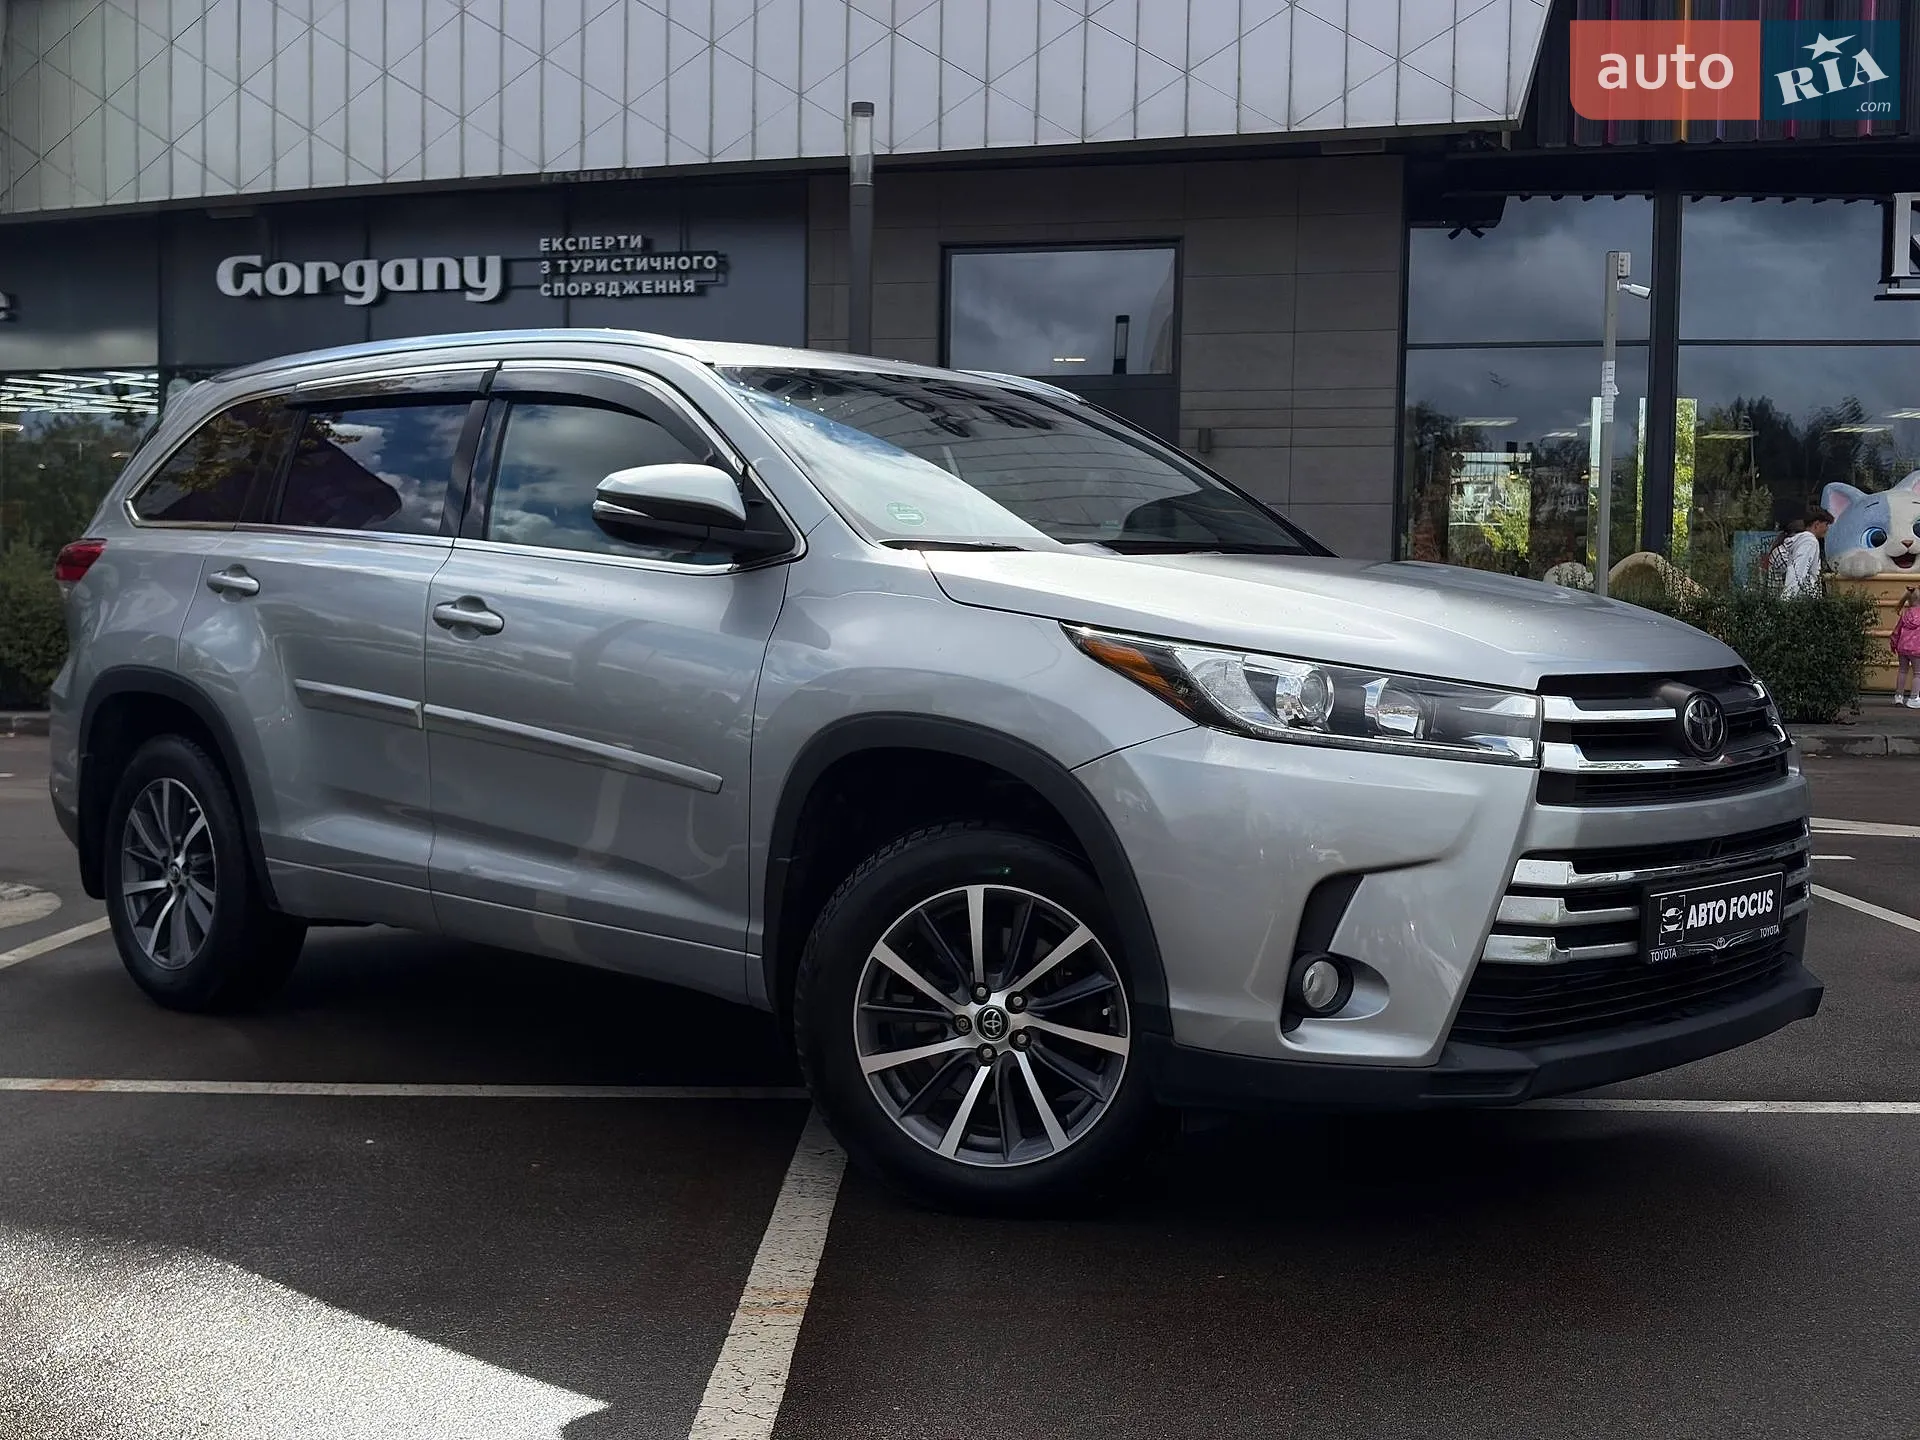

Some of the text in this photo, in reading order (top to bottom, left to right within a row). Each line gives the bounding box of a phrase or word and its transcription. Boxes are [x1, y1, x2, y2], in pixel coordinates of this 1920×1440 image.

[539, 235, 643, 251] ЕКСПЕРТИ
[558, 255, 718, 274] ТУРИСТИЧНОГО
[216, 254, 501, 306] Gorgany
[540, 279, 696, 297] СПОРЯДЖЕННЯ
[1729, 888, 1774, 921] FOCUS
[1759, 924, 1780, 938] TOYOTA
[1650, 947, 1677, 963] TOYOTA
